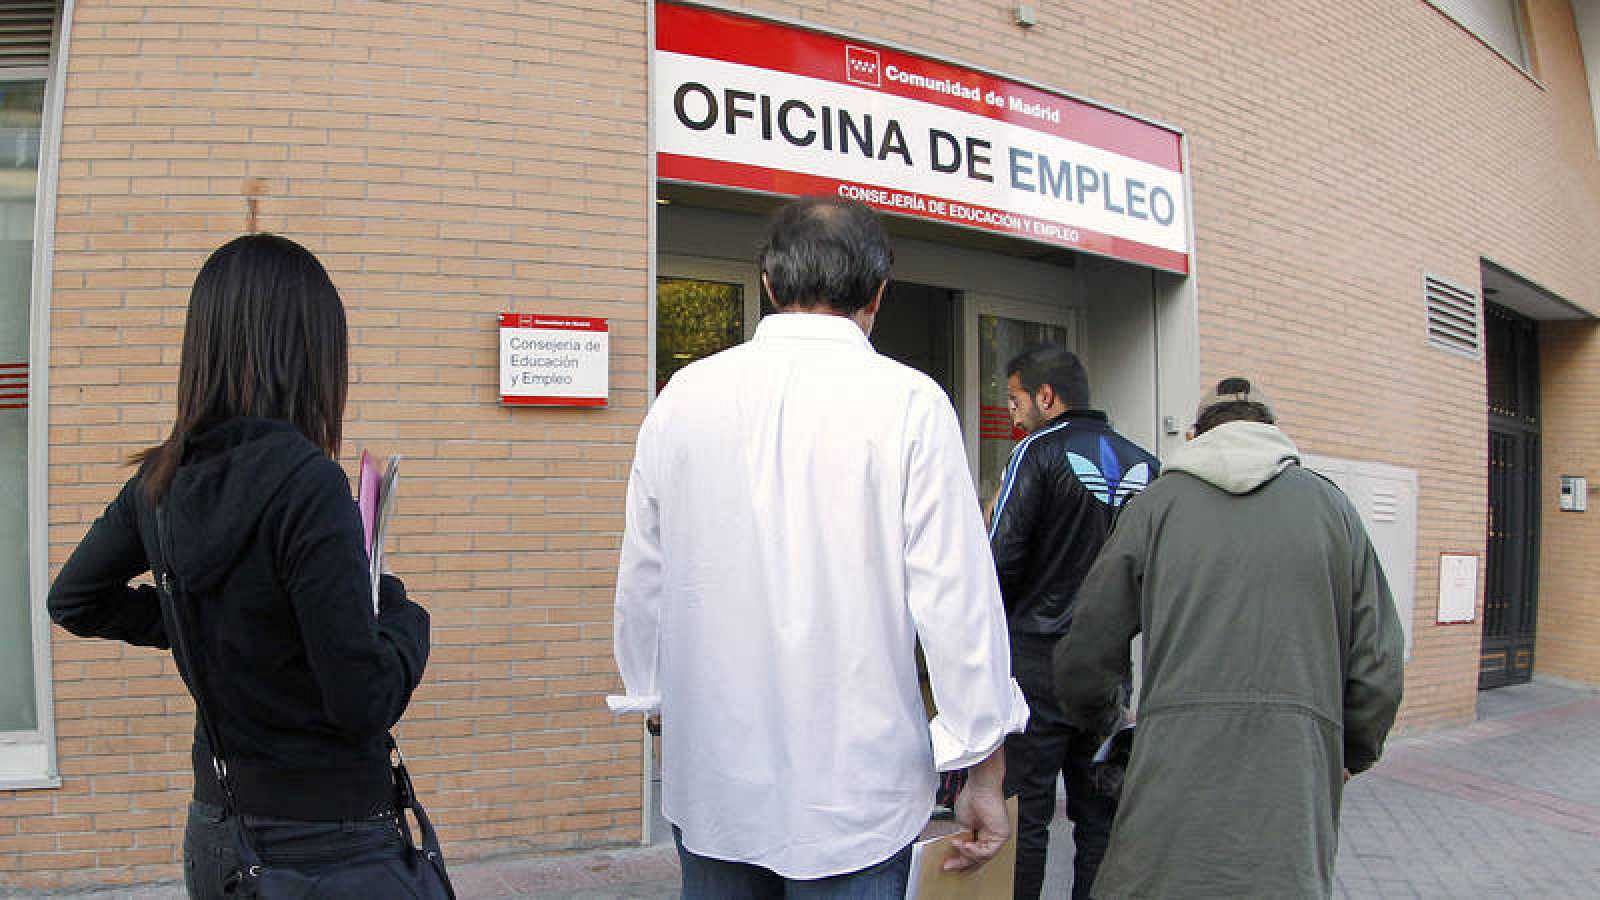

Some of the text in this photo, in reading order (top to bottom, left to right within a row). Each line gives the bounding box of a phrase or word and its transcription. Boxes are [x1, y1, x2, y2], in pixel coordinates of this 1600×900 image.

[885, 64, 1060, 123] Comunidad de Madrid
[673, 82, 1175, 226] OFICINA DE EMPLEO
[928, 199, 947, 216] DE
[1023, 218, 1032, 234] Y
[1033, 221, 1080, 242] EMPLEO
[585, 340, 601, 353] de
[511, 371, 573, 387] y Empleo
